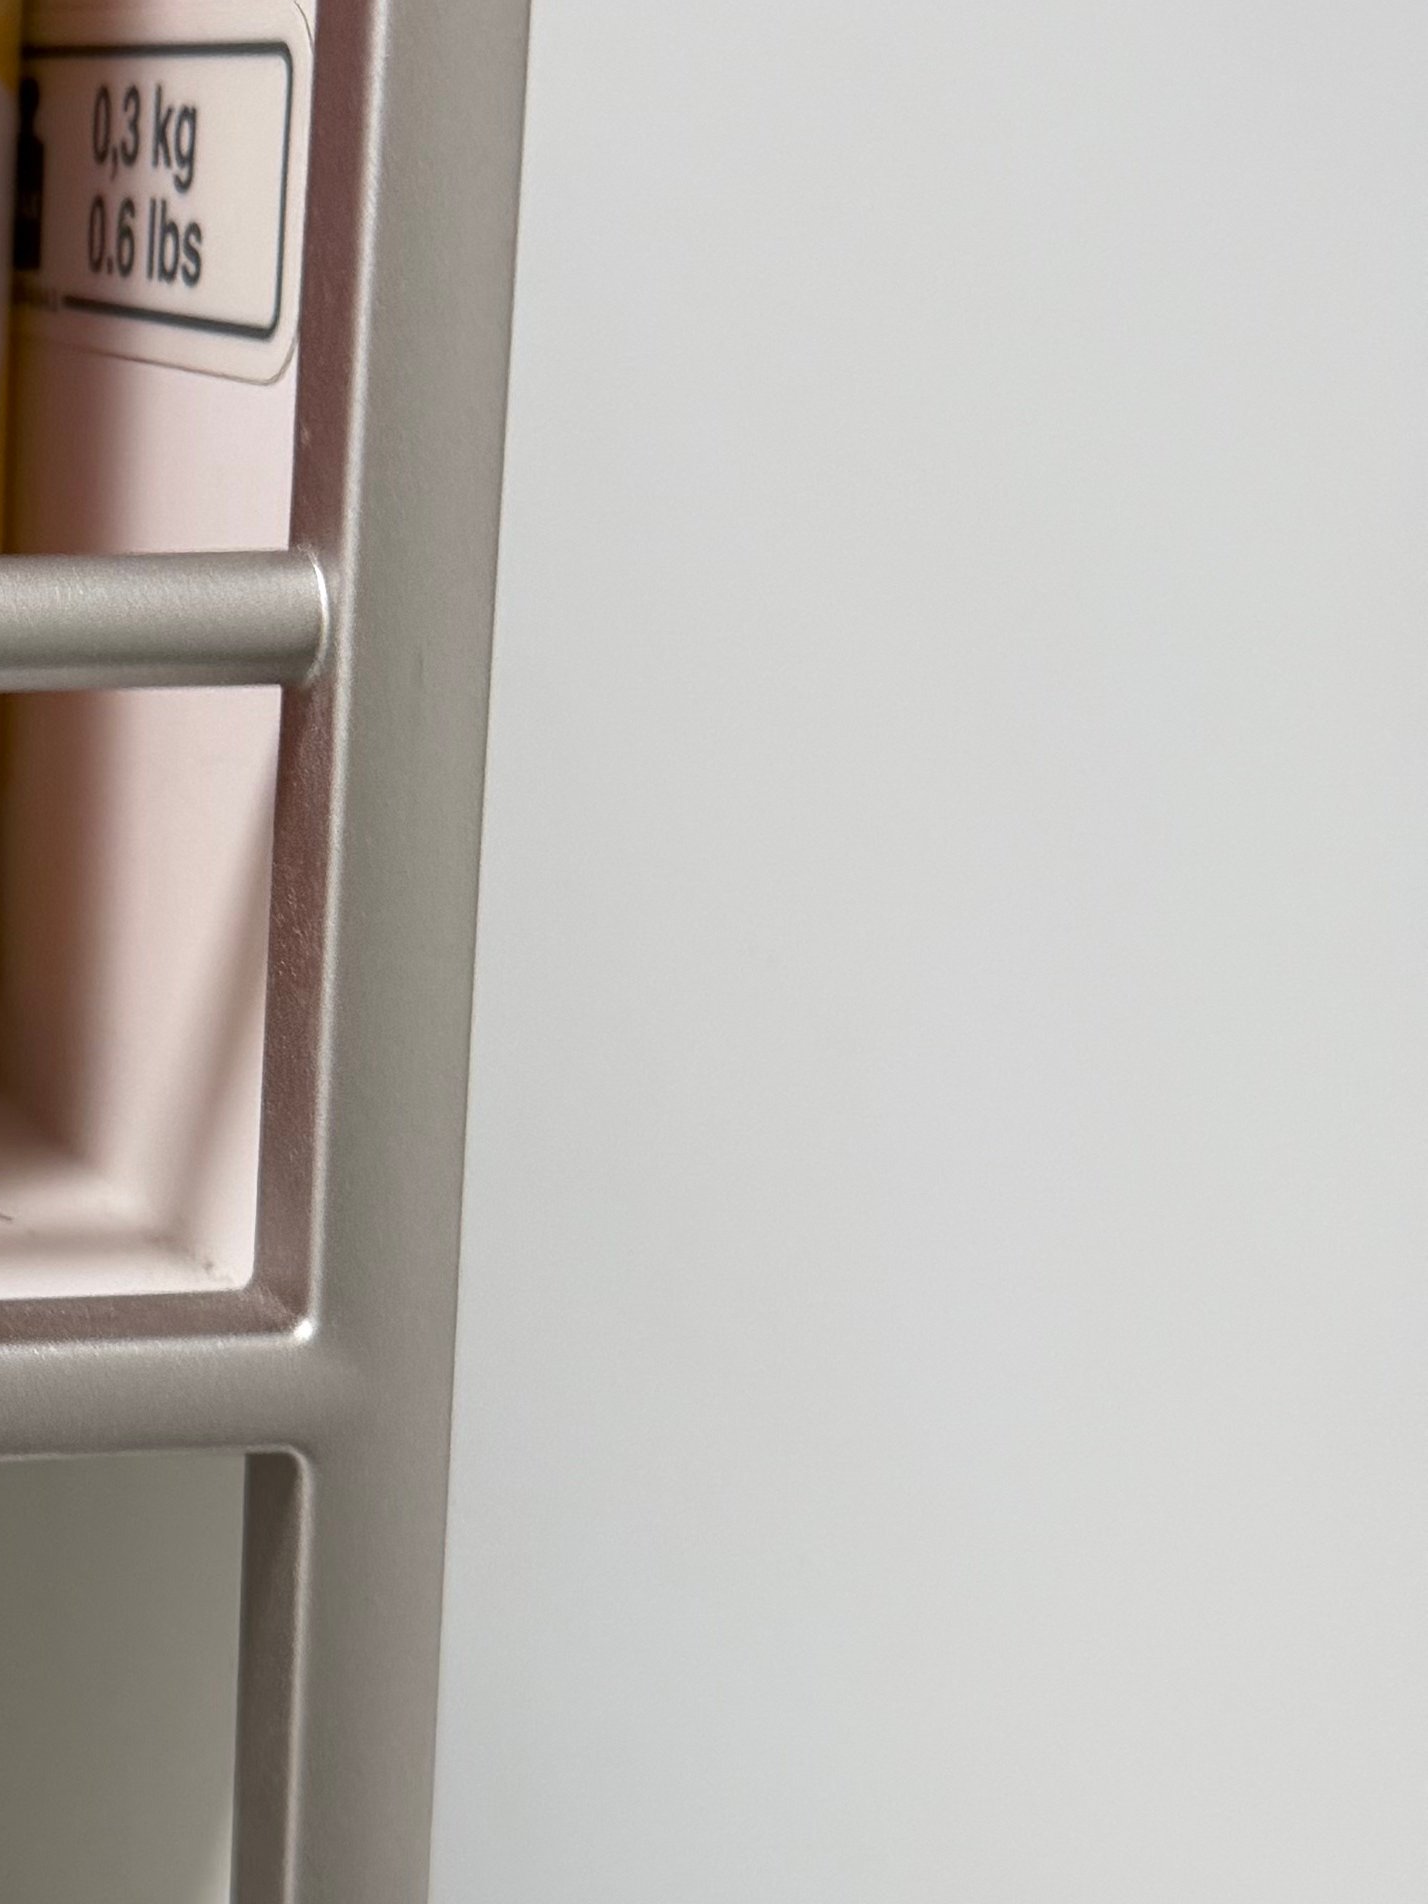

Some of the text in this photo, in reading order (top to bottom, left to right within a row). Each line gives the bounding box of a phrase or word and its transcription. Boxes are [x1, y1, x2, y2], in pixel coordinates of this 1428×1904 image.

[93, 80, 198, 194] 0,3 kg
[87, 195, 204, 289] 0.6 lbs
